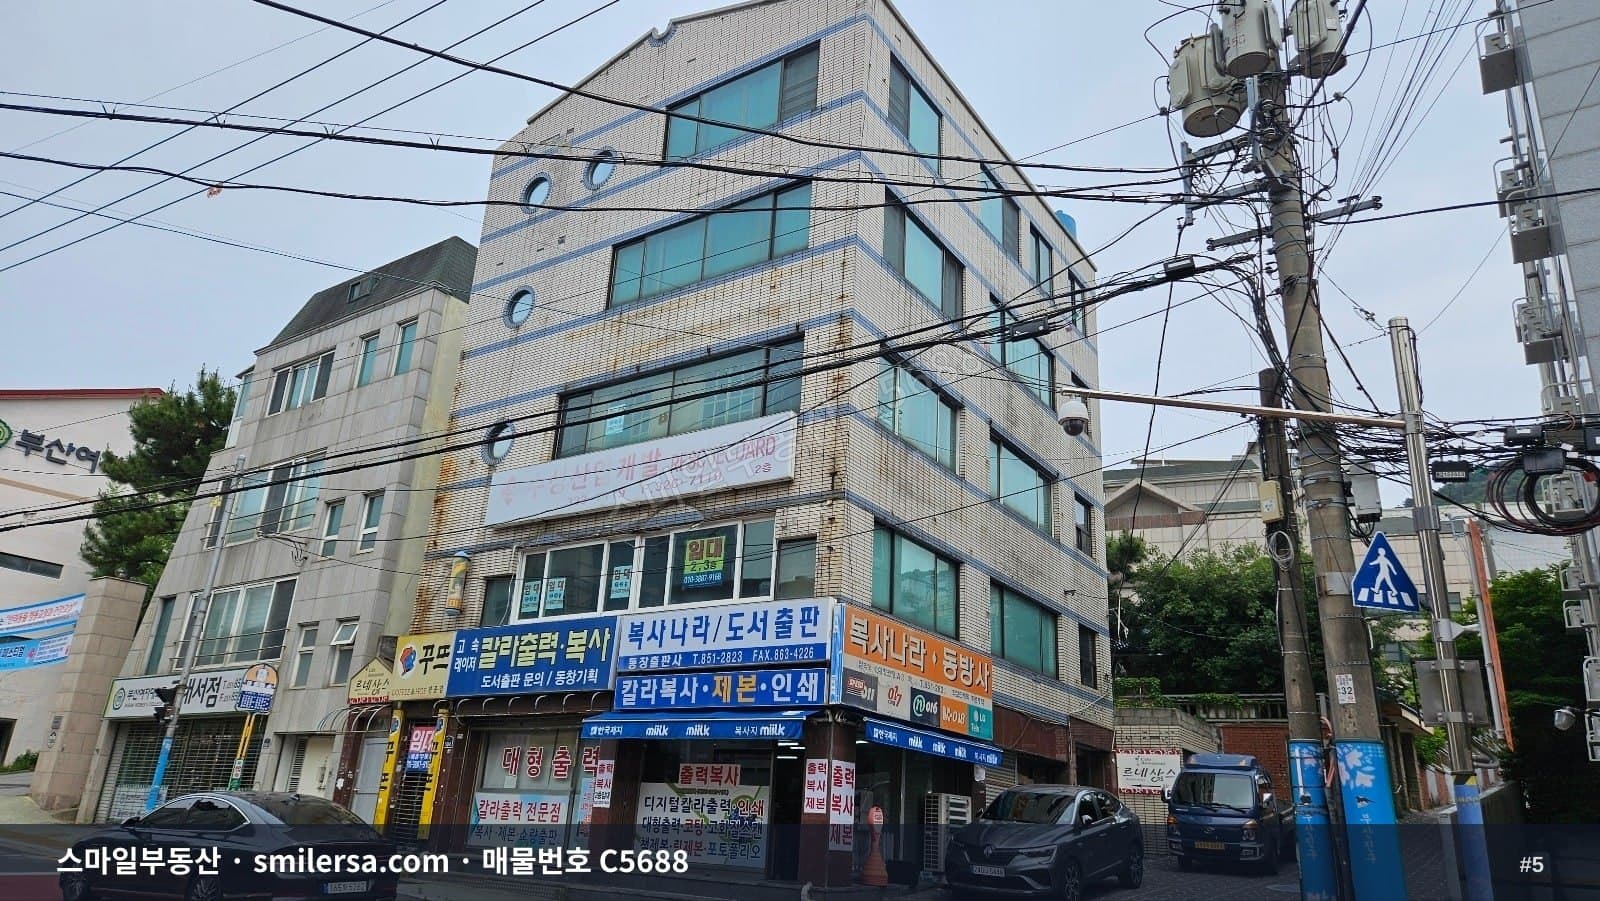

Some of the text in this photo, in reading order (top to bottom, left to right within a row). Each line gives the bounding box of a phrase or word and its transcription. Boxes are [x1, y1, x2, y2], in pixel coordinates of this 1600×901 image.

[15, 429, 101, 473] 부산여
[688, 538, 723, 561] 임대
[628, 606, 820, 650] 복사나라/도서출판
[454, 655, 476, 673] 레이저
[693, 651, 743, 665] T.851-2823
[753, 647, 814, 662] FAX.863-4226
[481, 673, 521, 689] 도서출판
[523, 671, 544, 687] 문의
[554, 668, 599, 685] 동창기획
[1341, 686, 1353, 695] 32
[926, 700, 938, 715] 016
[735, 726, 758, 736] 복사지
[680, 765, 739, 786] 출력복사
[808, 762, 827, 775] 출력
[833, 765, 855, 789] 출력
[1123, 767, 1176, 783] 르네상스
[596, 779, 612, 789] 복사
[807, 779, 826, 792] 복사
[478, 799, 561, 823] 칼라출력 전문점
[805, 797, 825, 810] 제본
[831, 793, 853, 817] 복사
[830, 823, 853, 846] 제본
